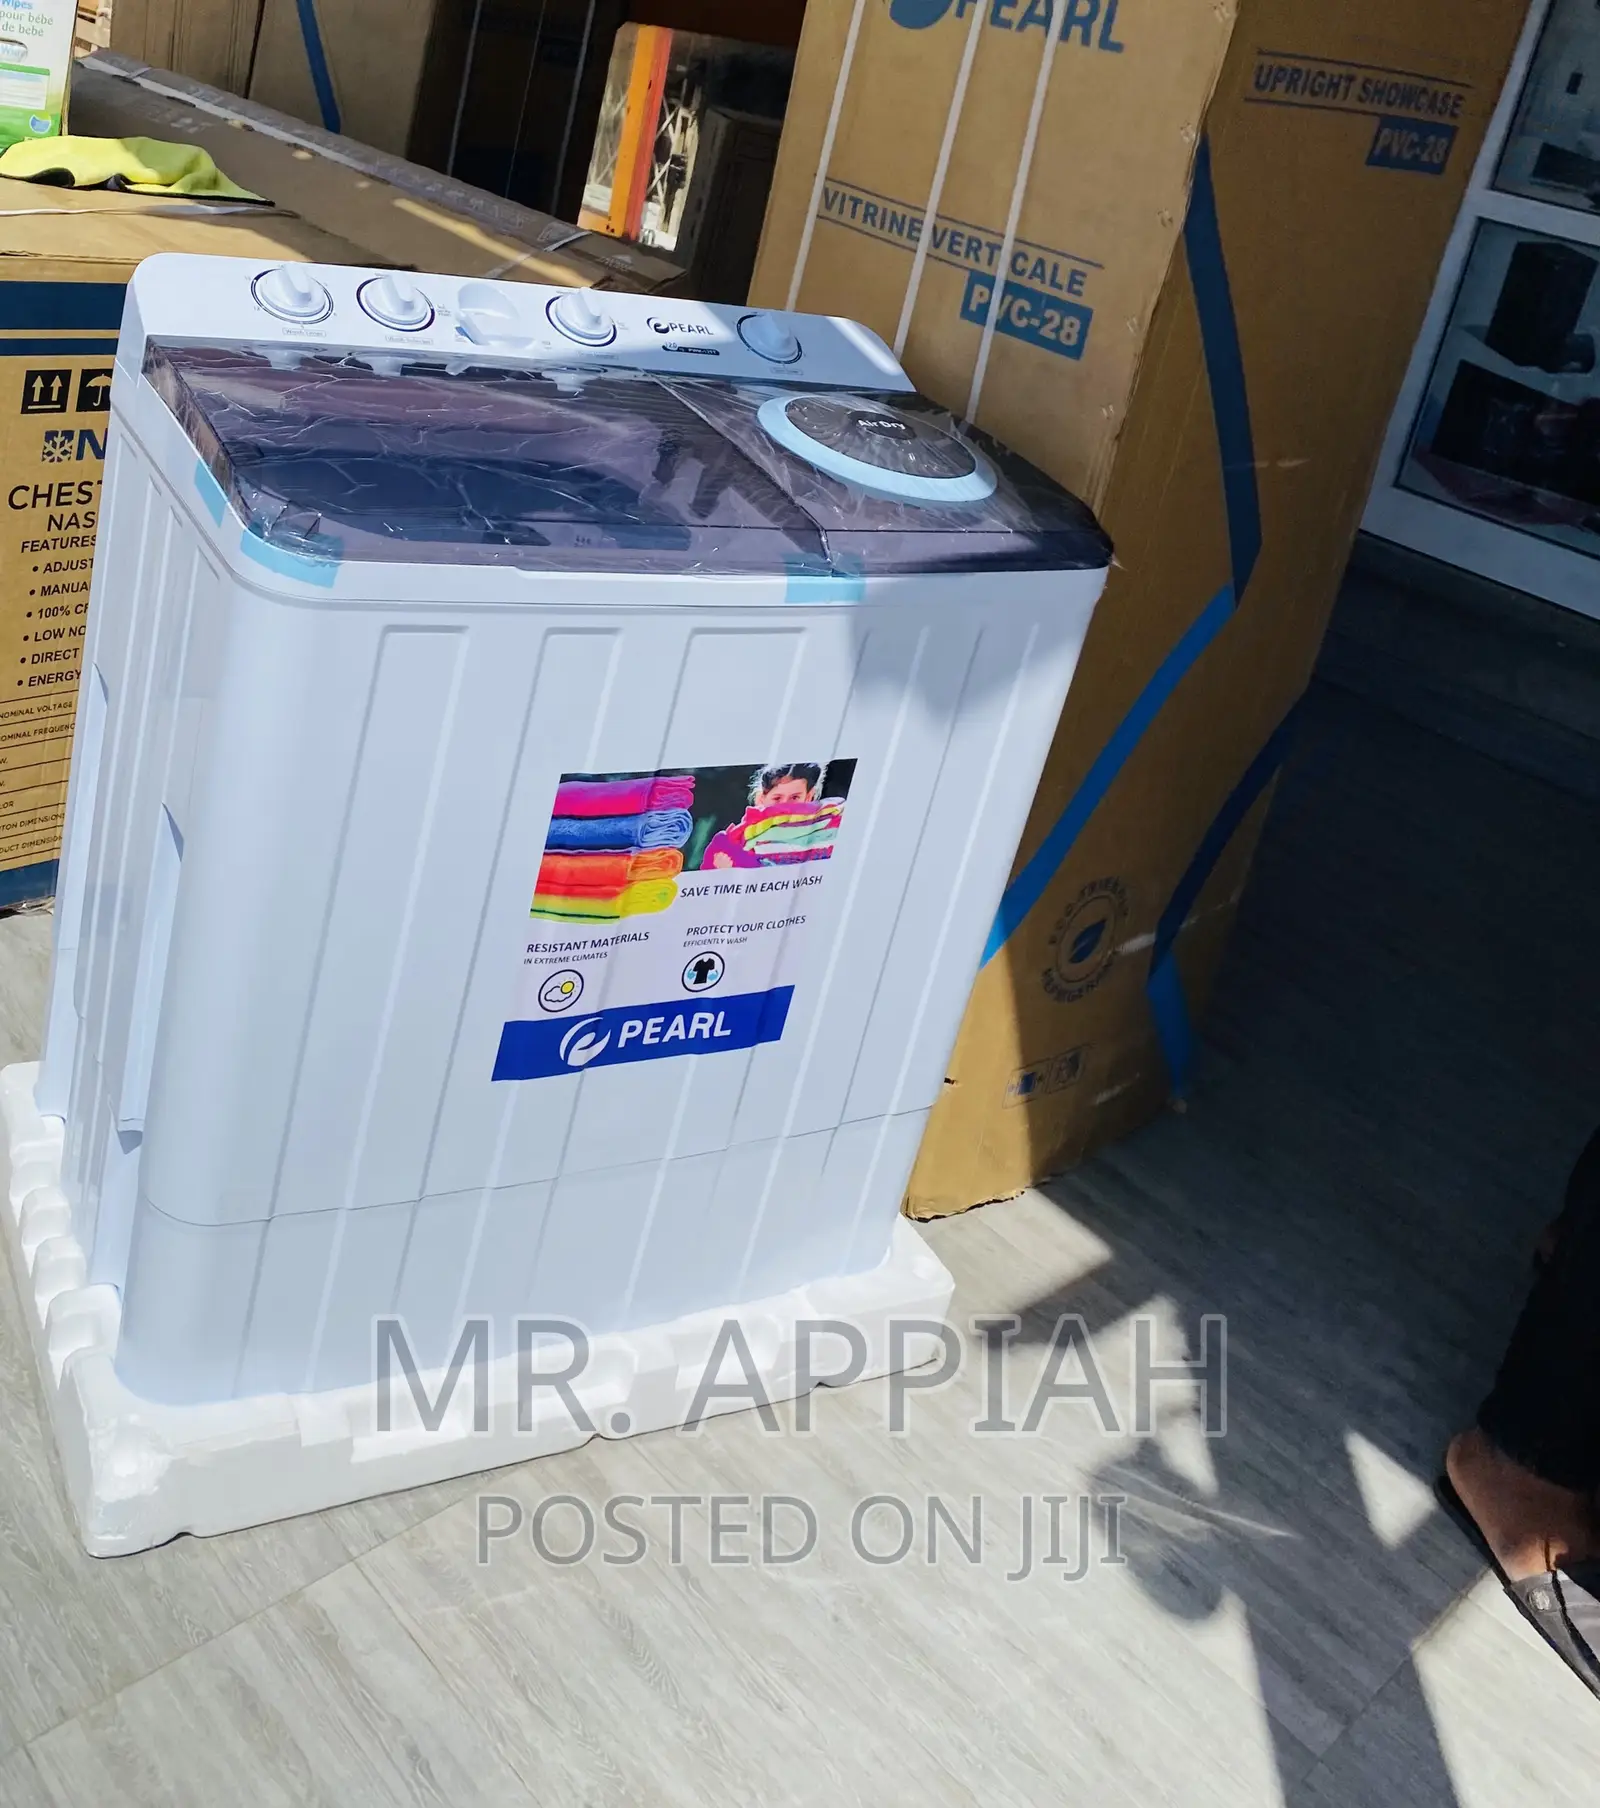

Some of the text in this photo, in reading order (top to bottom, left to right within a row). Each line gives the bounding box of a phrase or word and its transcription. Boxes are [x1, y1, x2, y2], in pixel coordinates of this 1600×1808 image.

[2, 21, 15, 32] de
[1255, 63, 1467, 119] UPRIGHT SHOWCASE
[1373, 127, 1450, 165] PVC-28
[823, 187, 1088, 298] VITRINE VERTCALE
[669, 322, 715, 336] PEARL
[858, 419, 906, 430] Air Dry
[8, 480, 103, 511] CHES
[37, 605, 70, 620] 100%
[34, 627, 66, 642] LOW
[31, 648, 80, 665] DIRECT
[28, 669, 82, 687] ENERGY
[37, 701, 73, 713] VOLTAGE
[680, 875, 824, 898] SAVE TIME IN EACH WASH
[686, 915, 807, 936] PROTECT YOUR CLOTHES
[526, 931, 650, 953] RESISTANT MATERIALS
[683, 936, 748, 947] EFFICIENTLY WASH
[524, 951, 608, 965] IN EXTREME CLIMATES
[617, 1010, 733, 1049] PEARL
